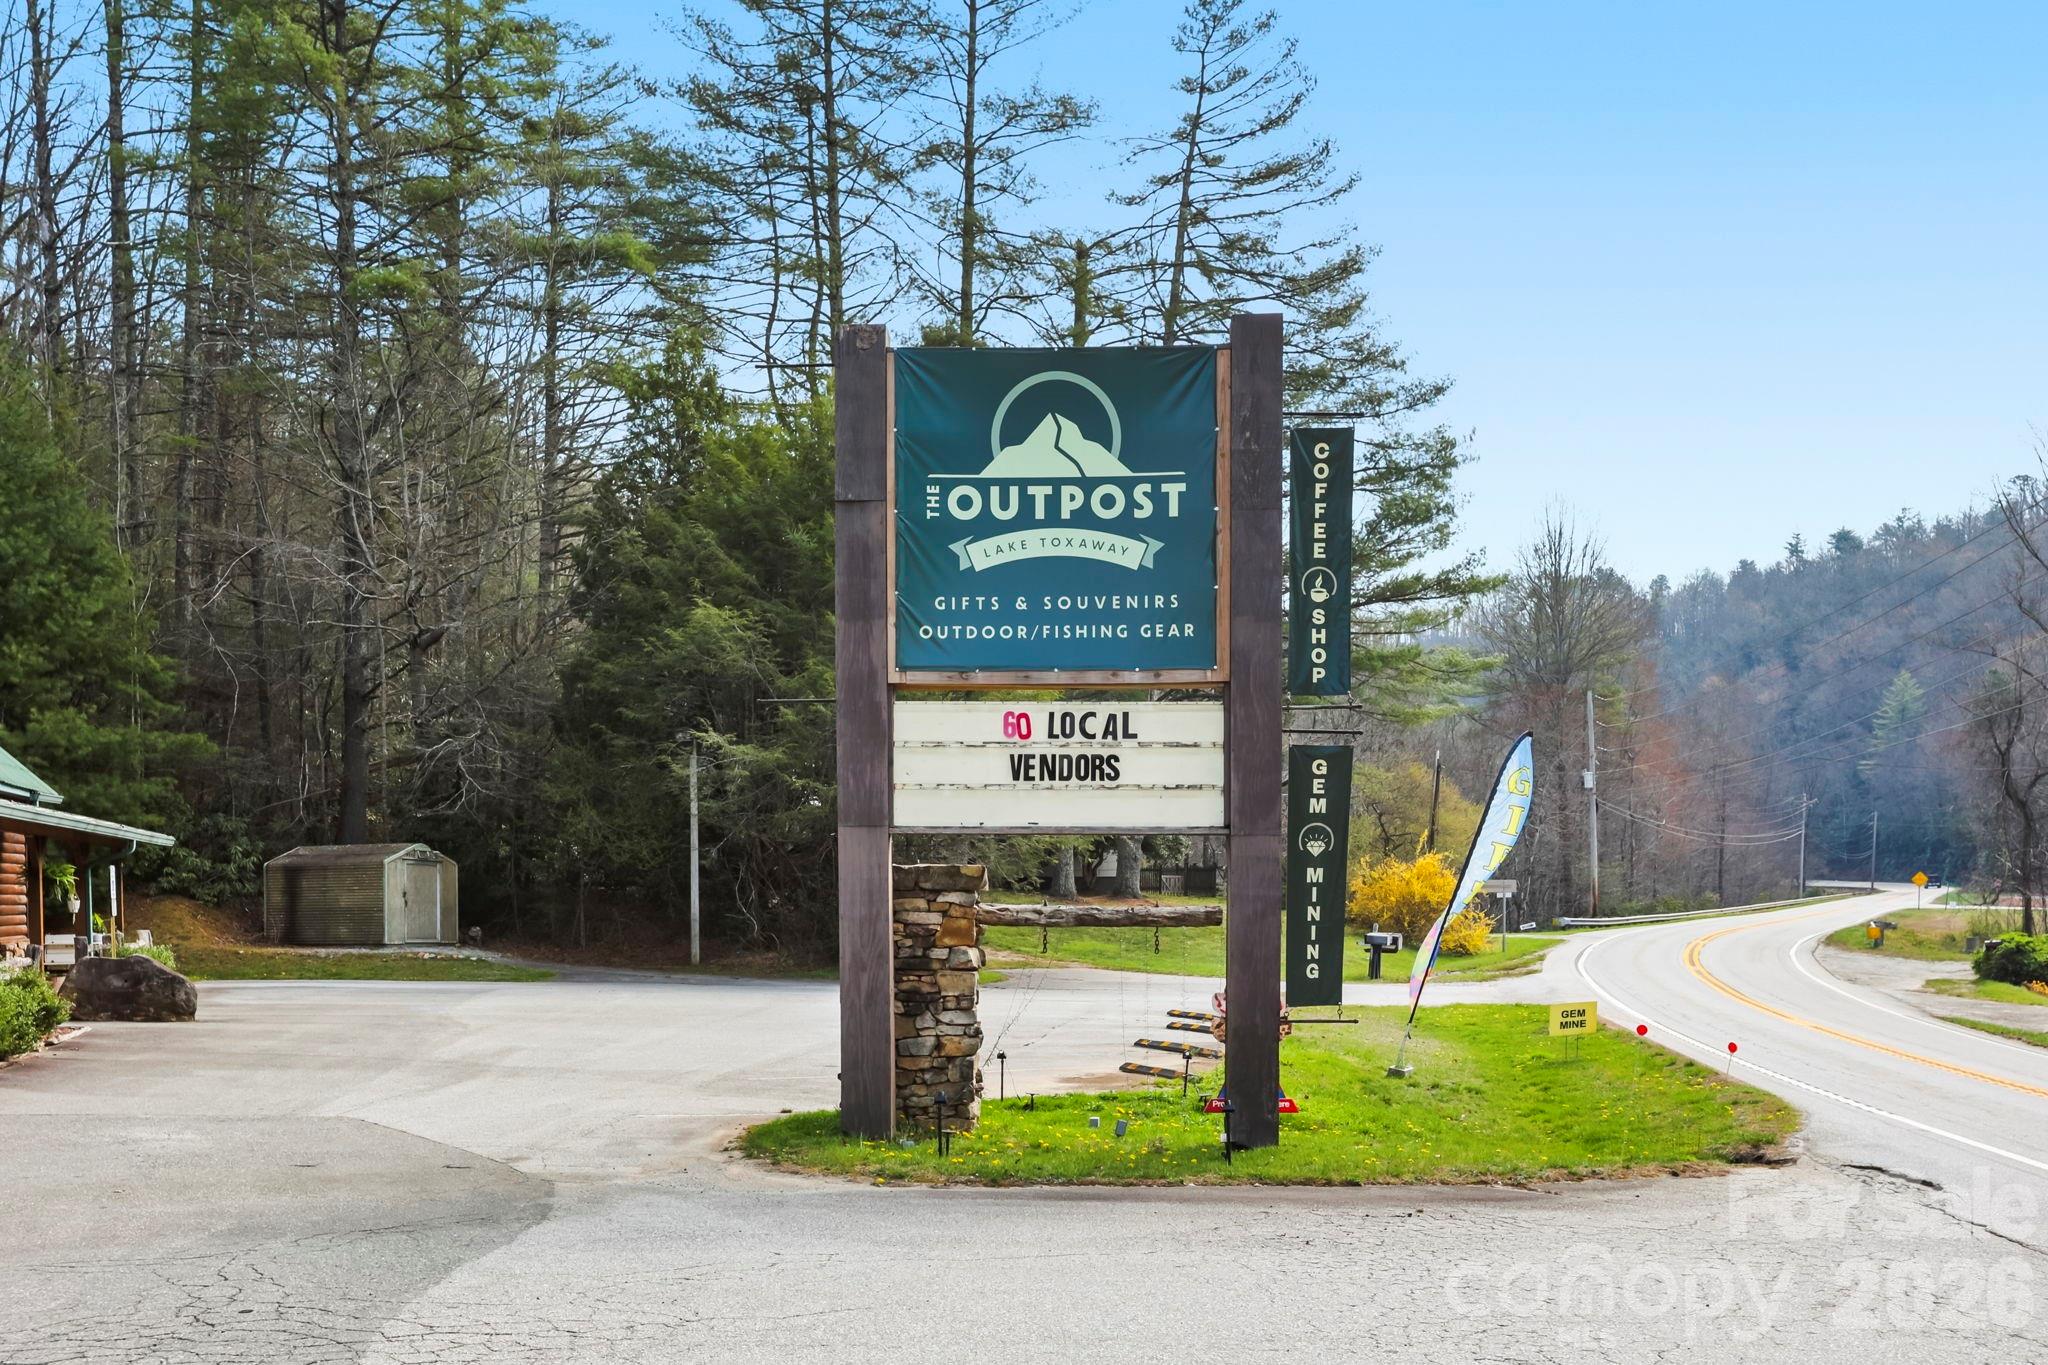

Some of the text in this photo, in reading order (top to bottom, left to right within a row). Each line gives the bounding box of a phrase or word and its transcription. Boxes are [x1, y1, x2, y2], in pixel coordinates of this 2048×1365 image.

[926, 482, 1187, 521] THE OUTPOST
[1313, 442, 1330, 559] COFFEE
[983, 536, 1130, 558] LAKE TOXAWAY
[934, 594, 1180, 611] GIFTS & SOUVENIRS
[919, 623, 1195, 641] OUTDOOR/FISHING GEAR
[1310, 608, 1327, 684] SHOP
[1002, 710, 1139, 741] 60 LOCAL
[1009, 753, 1121, 782] VENDORS
[1308, 759, 1328, 814] GEM
[1306, 867, 1324, 979] MINING
[1559, 1019, 1587, 1030] MINE
[1561, 1008, 1586, 1019] GEM
